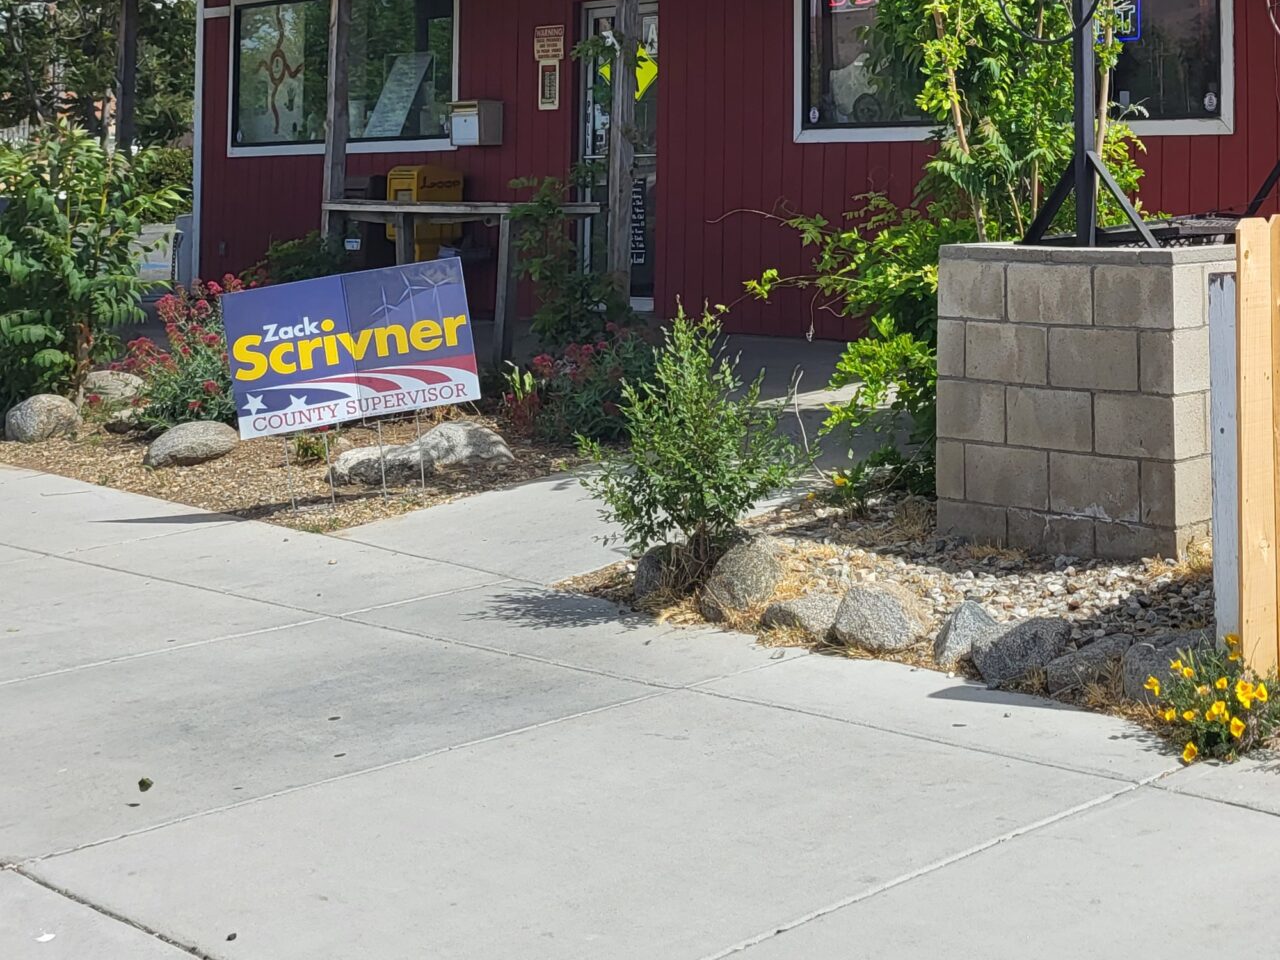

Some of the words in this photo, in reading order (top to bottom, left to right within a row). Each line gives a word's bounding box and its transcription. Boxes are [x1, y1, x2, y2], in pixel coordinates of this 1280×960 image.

[232, 314, 467, 381] Scrivner
[263, 316, 320, 343] Zack
[252, 403, 339, 432] COUNTY
[346, 383, 468, 415] SUPERVISOR
